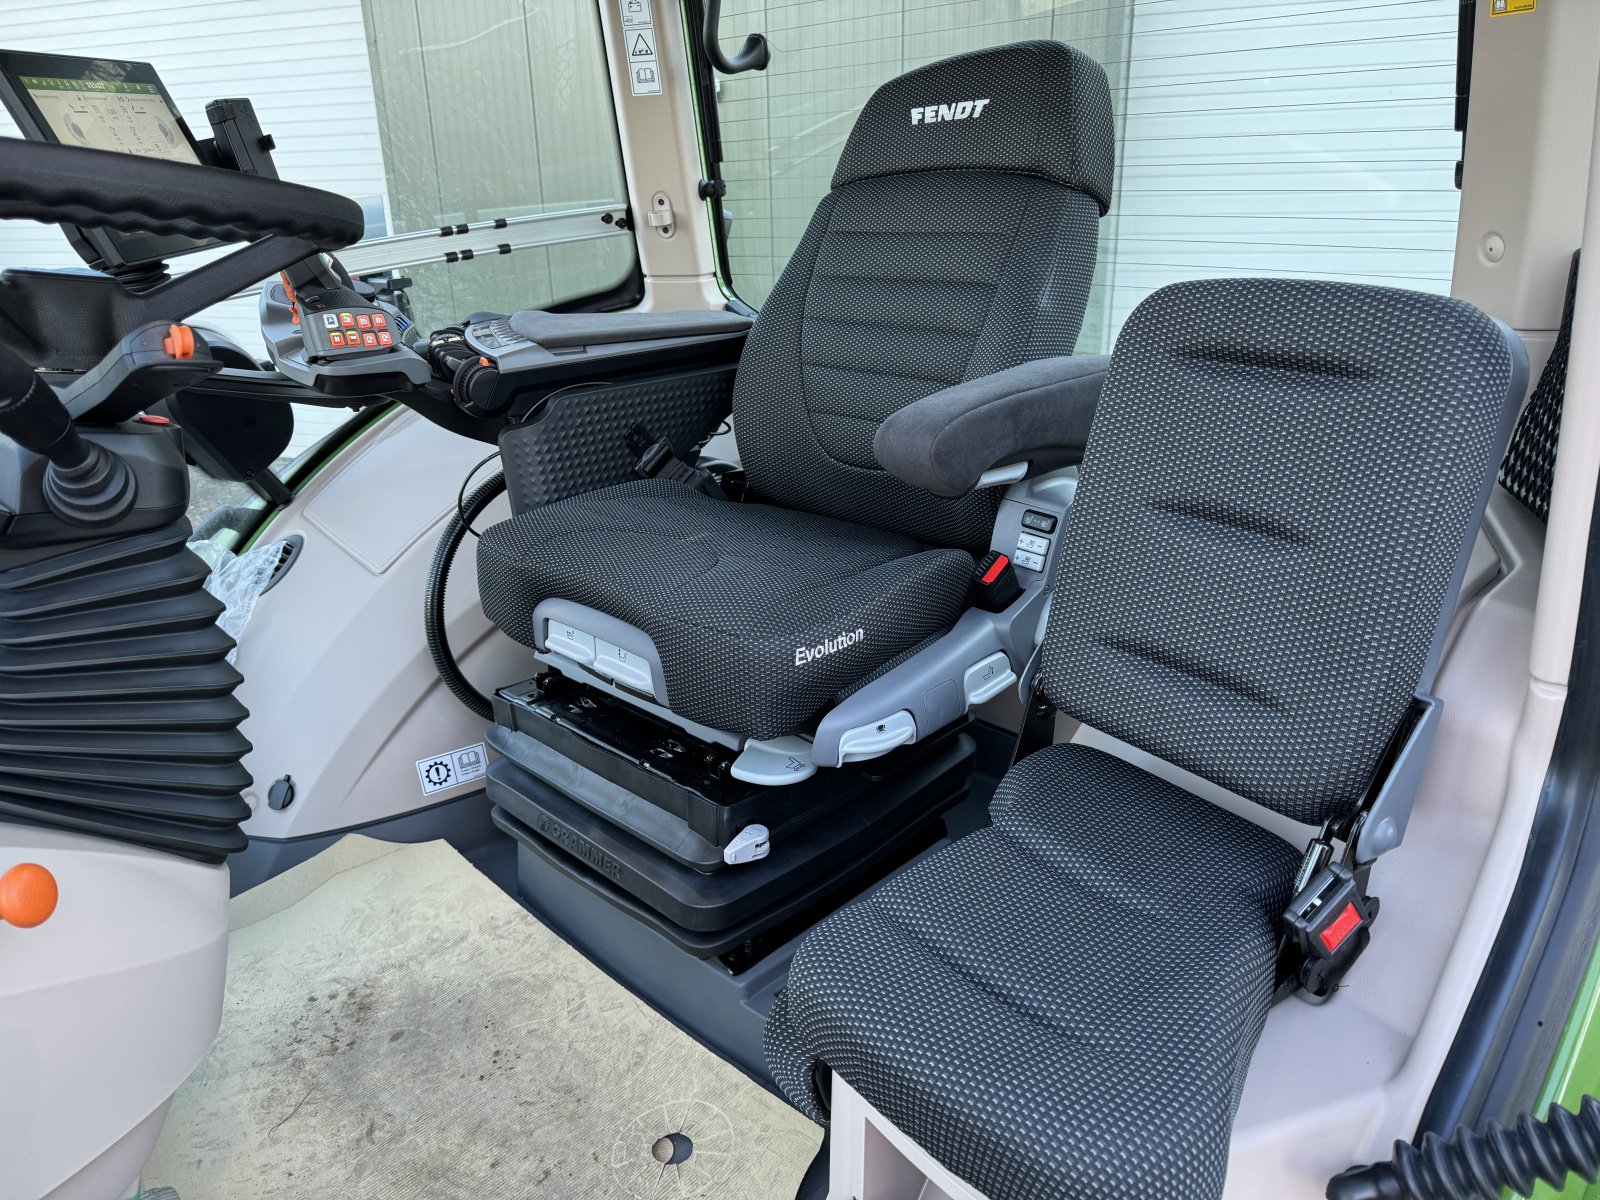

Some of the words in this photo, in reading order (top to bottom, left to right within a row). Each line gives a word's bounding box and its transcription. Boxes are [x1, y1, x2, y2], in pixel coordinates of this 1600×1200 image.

[910, 98, 990, 125] FENDT
[795, 628, 864, 666] Evolution
[551, 823, 623, 879] GRAMMER
